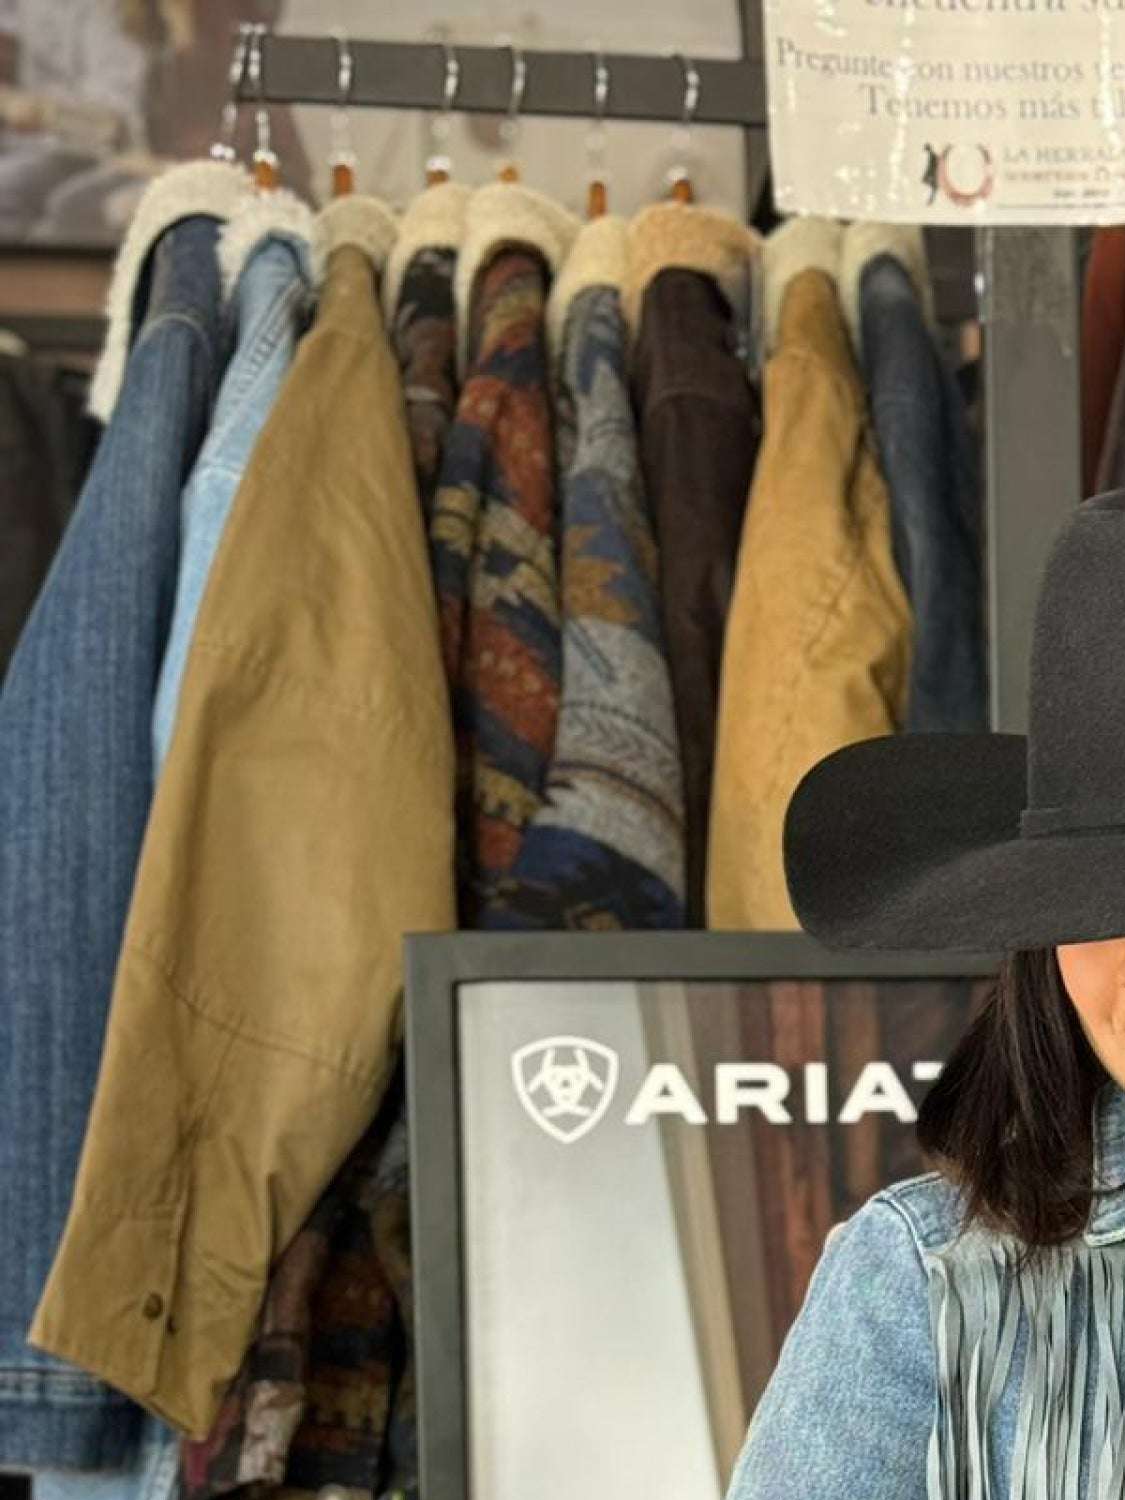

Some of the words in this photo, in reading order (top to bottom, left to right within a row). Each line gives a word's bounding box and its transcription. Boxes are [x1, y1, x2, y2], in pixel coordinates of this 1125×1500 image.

[776, 37, 895, 80] Pregunte
[908, 61, 954, 82] on
[963, 60, 1084, 82] nuestros
[858, 84, 1007, 120] Tenemos
[1018, 90, 1080, 120] más
